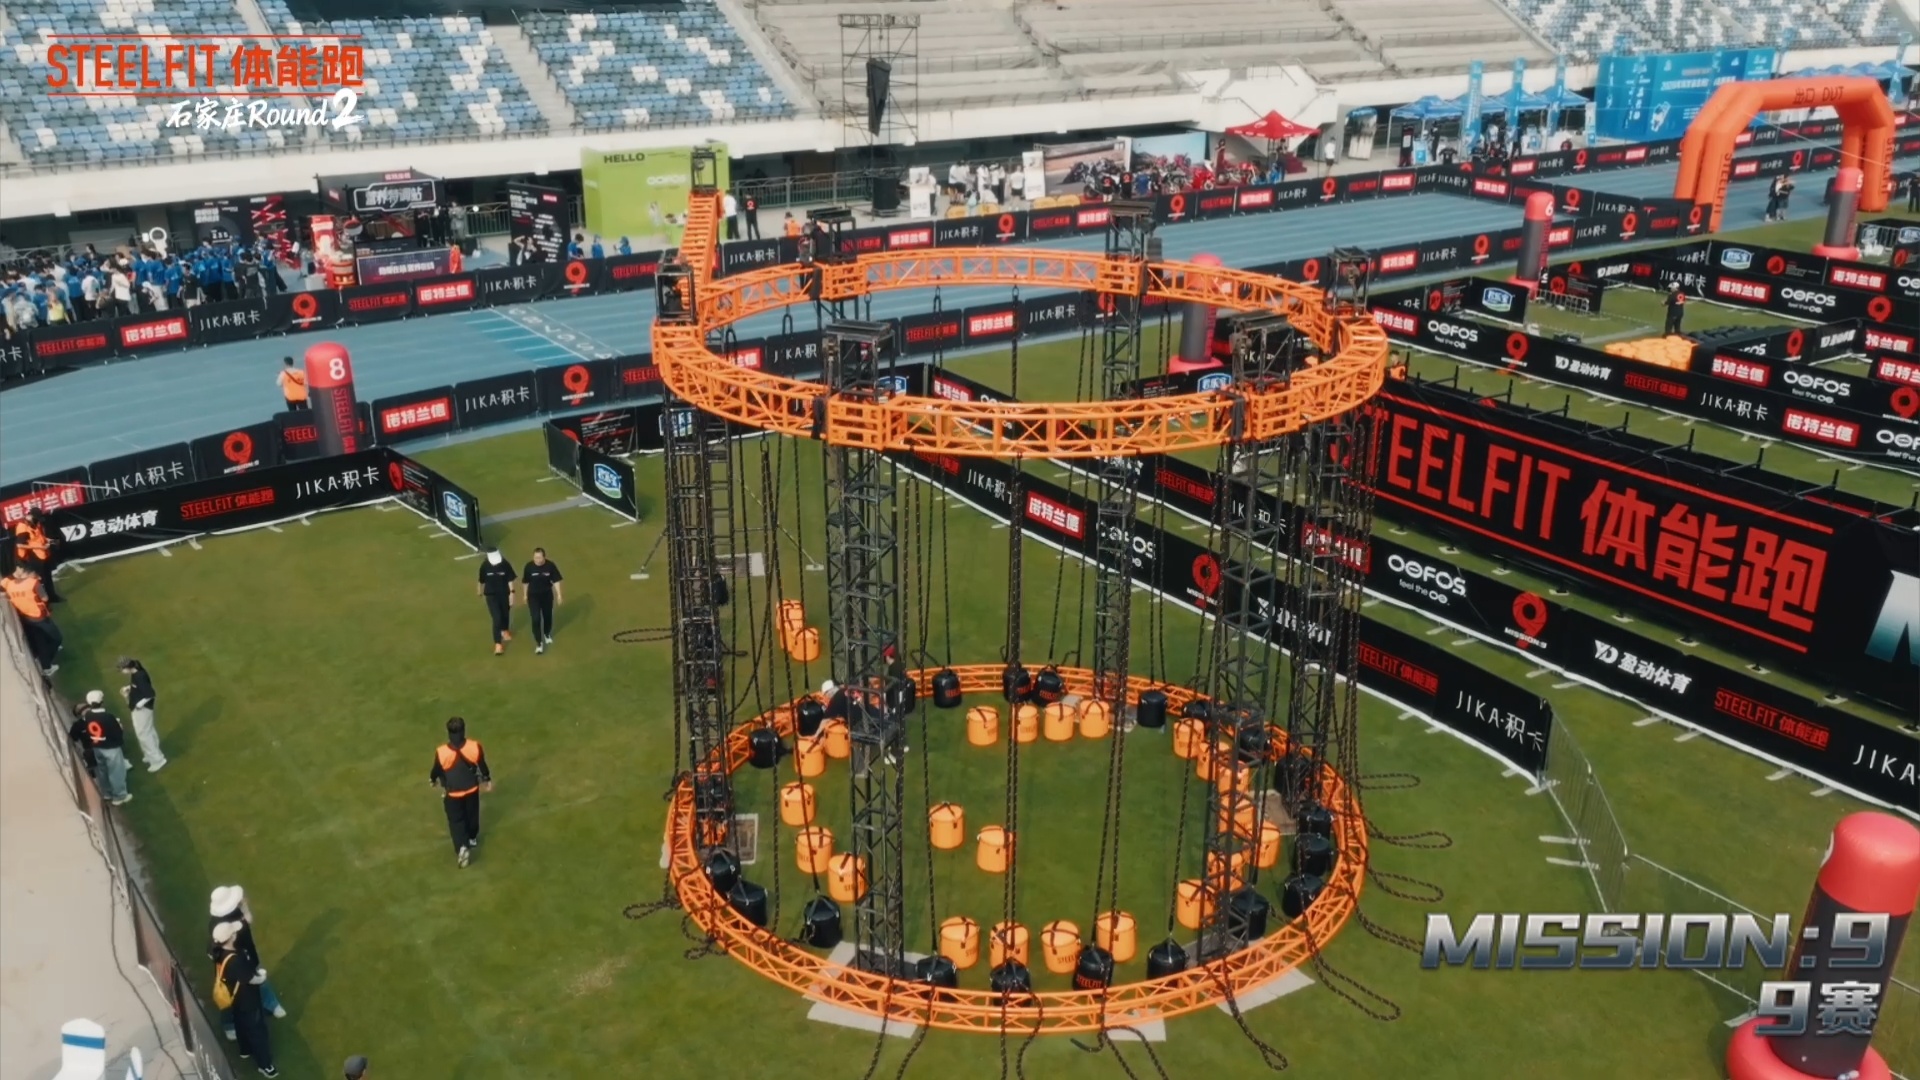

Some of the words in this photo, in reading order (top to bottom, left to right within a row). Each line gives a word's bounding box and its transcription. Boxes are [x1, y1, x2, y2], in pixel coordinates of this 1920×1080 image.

[604, 153, 645, 164] HELLO
[1545, 201, 1553, 216] 6
[729, 250, 776, 265] JIKA·积卡
[484, 274, 537, 294] JIKA·积卡
[1781, 287, 1836, 307] OOFOS
[200, 310, 261, 332] JIKA·积卡
[1029, 304, 1076, 323] JIKA·积卡
[1427, 320, 1478, 343] OOFOS
[329, 358, 346, 380] 8
[1783, 370, 1850, 397] OOFOS
[465, 386, 530, 412] JIKA·积卡
[1701, 392, 1768, 421] JIKA·积卡
[386, 403, 446, 429] 诺特兰德
[1787, 412, 1854, 442] 诺特兰德
[104, 462, 185, 496] JIKA·积卡
[296, 466, 380, 498] JIKA·积卡
[180, 497, 233, 519] STEELFIT
[1028, 496, 1081, 531] 诺特兰德
[89, 510, 158, 538] 盈动体育
[1580, 477, 1828, 633] 体能跑
[1388, 554, 1466, 597] OOFOS
[1415, 584, 1428, 597] the
[1594, 640, 1618, 664] YD
[1619, 651, 1692, 694] 盈动体育
[1715, 690, 1777, 729] STEELFIT
